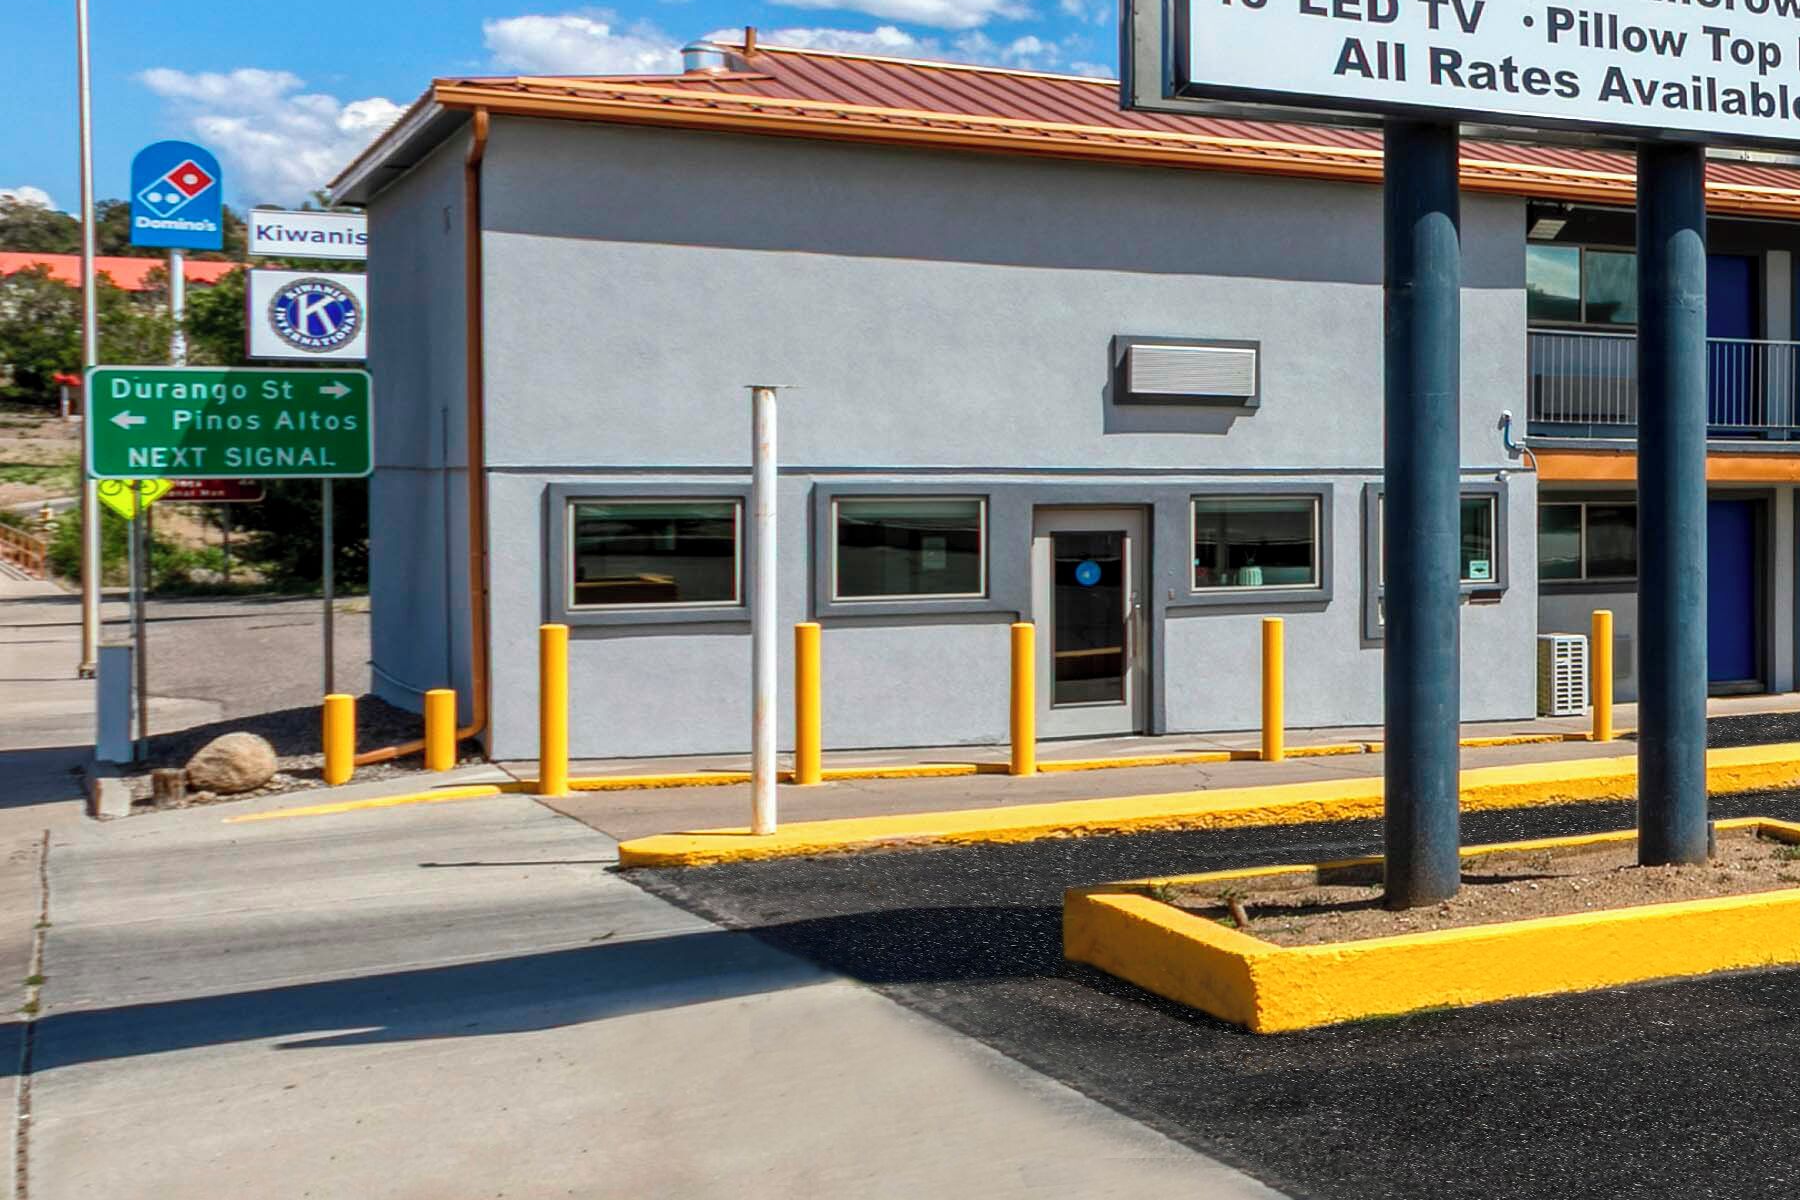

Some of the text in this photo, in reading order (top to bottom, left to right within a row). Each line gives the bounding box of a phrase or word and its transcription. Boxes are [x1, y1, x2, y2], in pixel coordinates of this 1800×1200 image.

[1546, 6, 1688, 58] Pillow
[1702, 25, 1782, 76] Top
[1333, 37, 1406, 82] All
[1429, 46, 1580, 99] Rates
[256, 224, 368, 246] Kiwanis
[285, 284, 347, 302] KIWANIS
[275, 307, 356, 347] INTERNATIONAL
[297, 293, 337, 337] K
[111, 378, 293, 405] Durango St
[172, 409, 358, 431] Pinos Altos
[128, 447, 336, 468] NEXT SIGNAL
